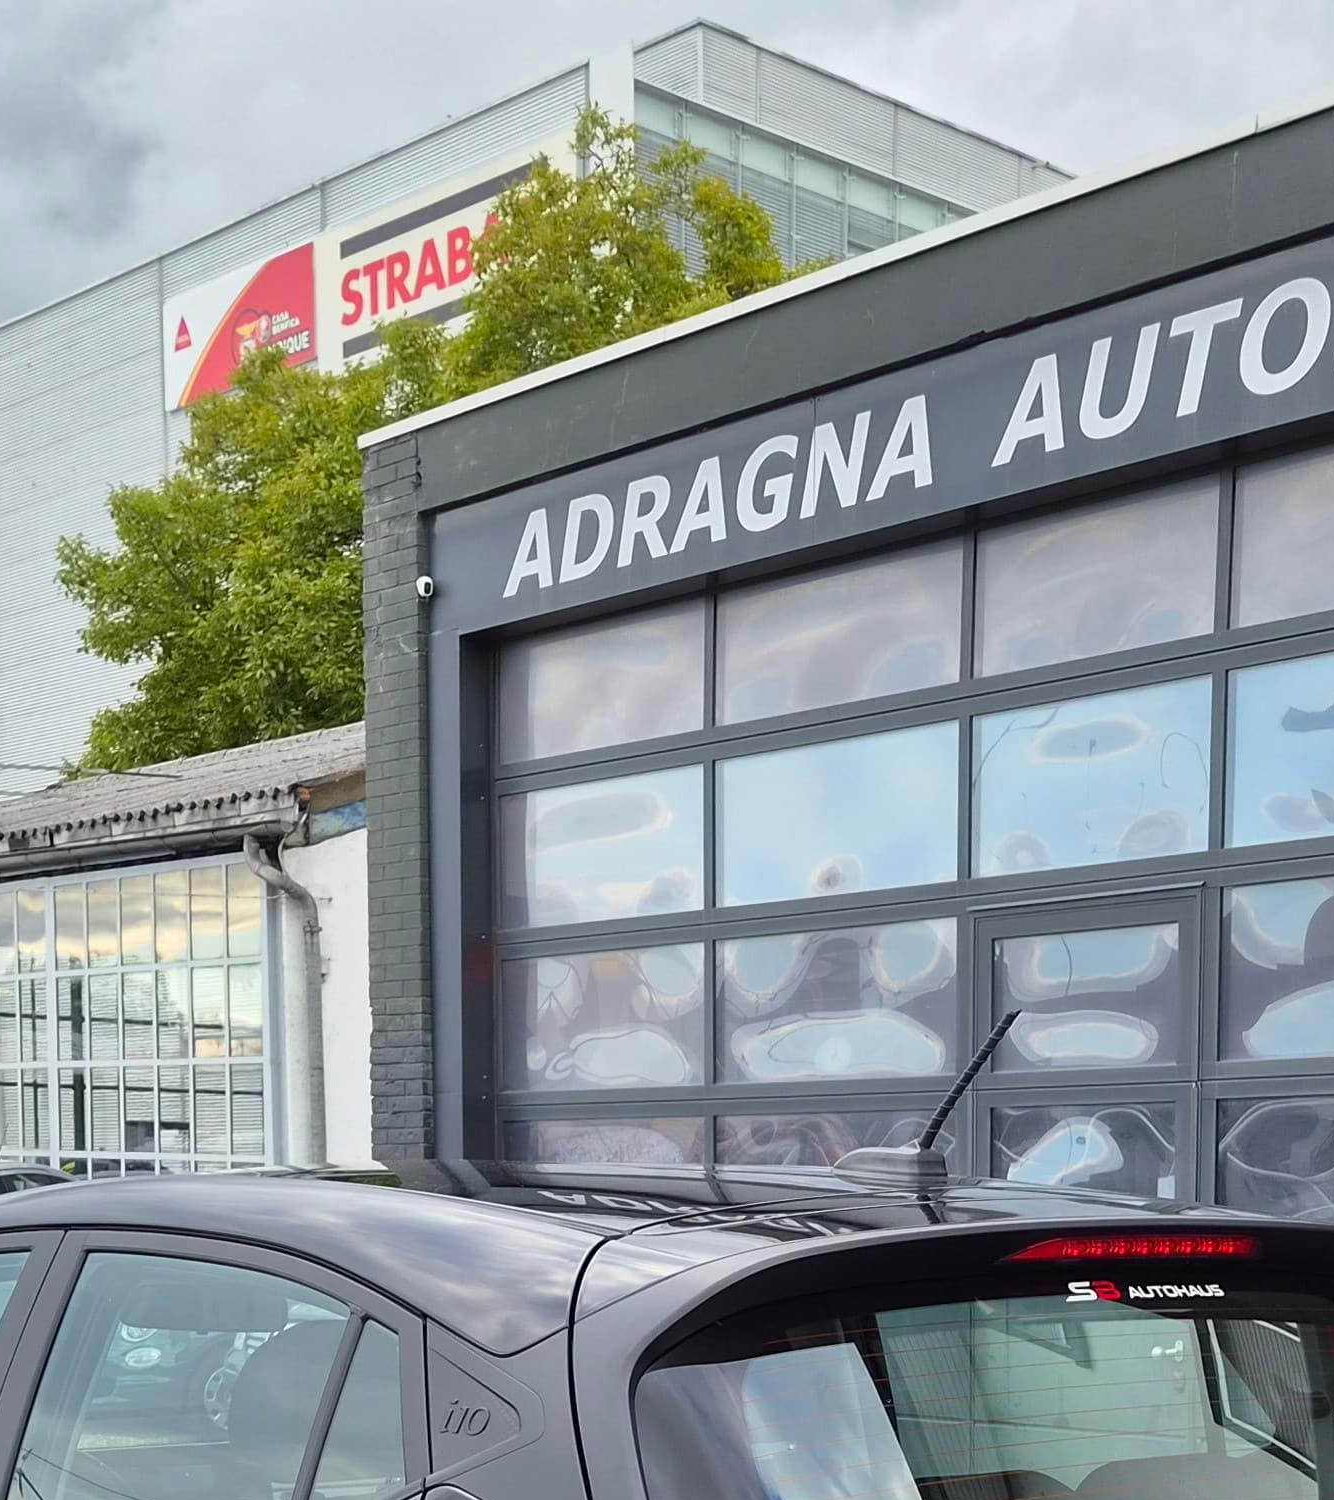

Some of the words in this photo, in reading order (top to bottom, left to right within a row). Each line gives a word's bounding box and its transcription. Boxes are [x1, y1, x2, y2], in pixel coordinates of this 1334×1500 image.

[502, 394, 933, 600] ADRAGNA
[1128, 1284, 1225, 1299] AUTOHAUS
[439, 1399, 491, 1436] i10
